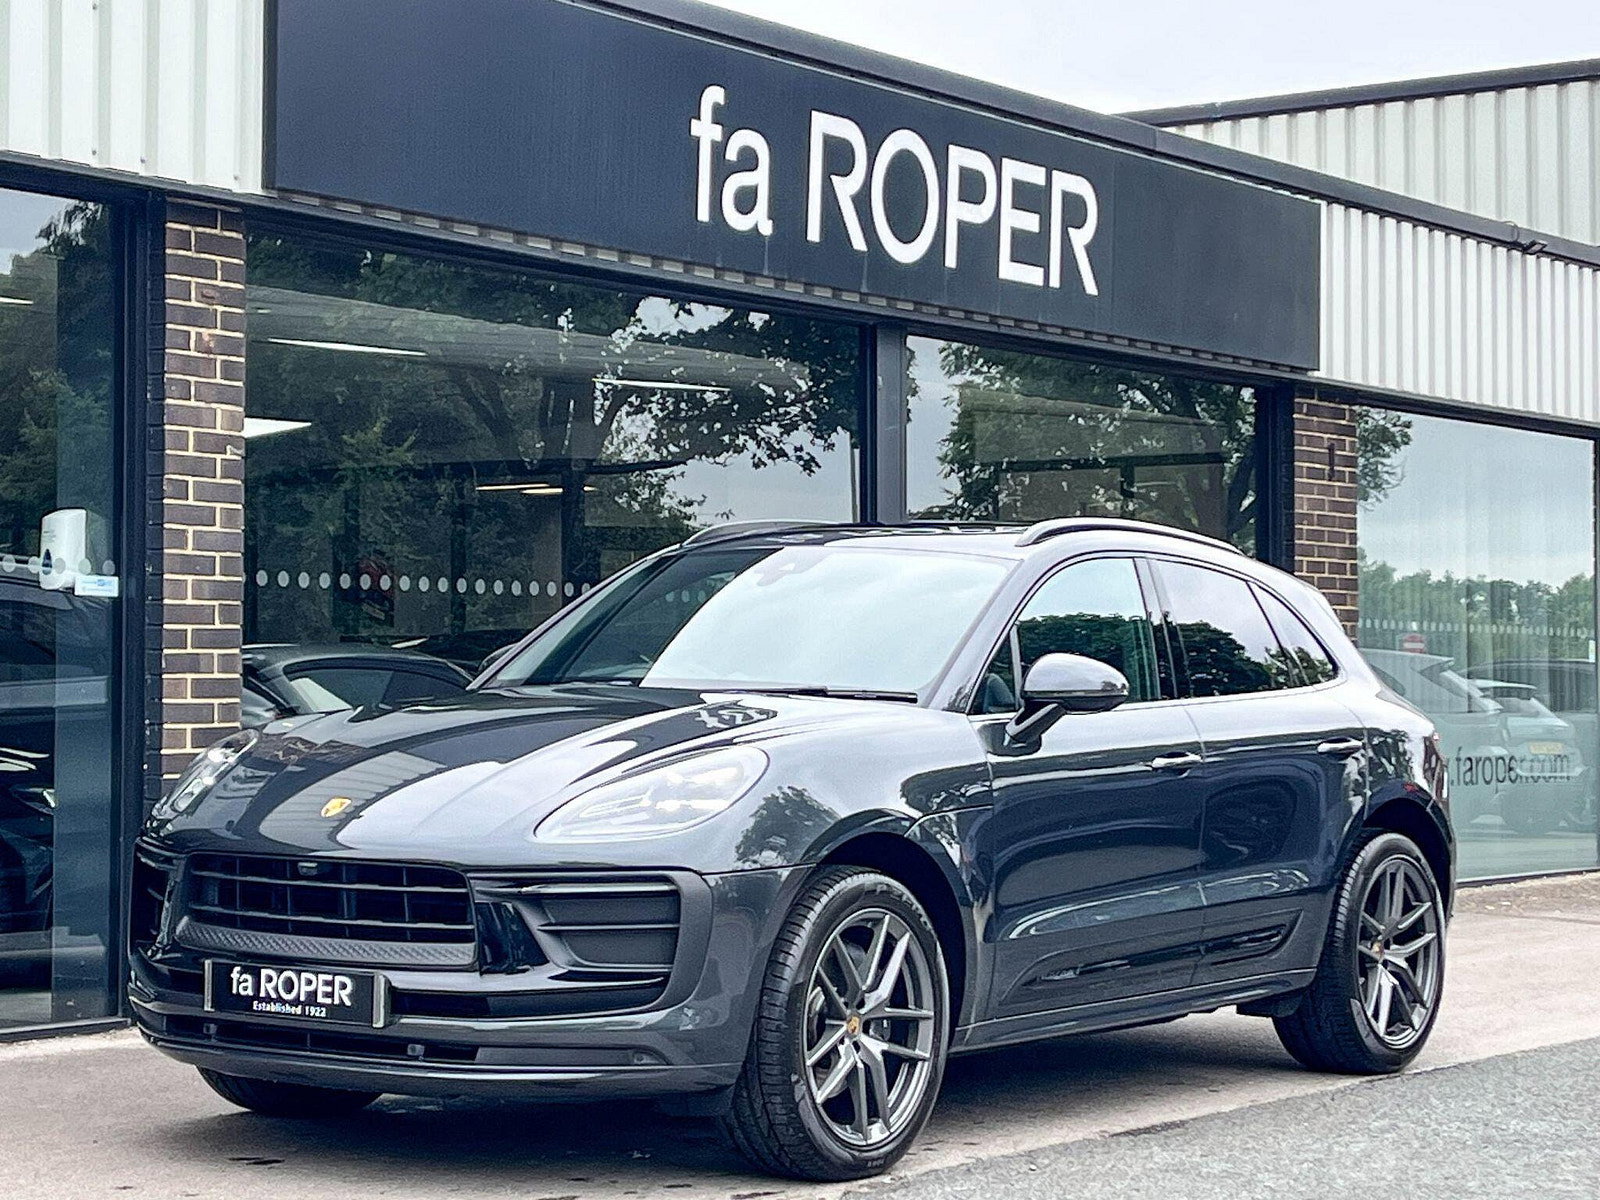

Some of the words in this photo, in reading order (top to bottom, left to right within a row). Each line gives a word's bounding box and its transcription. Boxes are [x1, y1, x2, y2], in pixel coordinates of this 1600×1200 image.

[690, 85, 773, 236] fa
[806, 110, 1099, 296] ROPER
[230, 966, 253, 996] fa
[259, 968, 353, 1007] ROPER
[252, 1001, 302, 1015] Established
